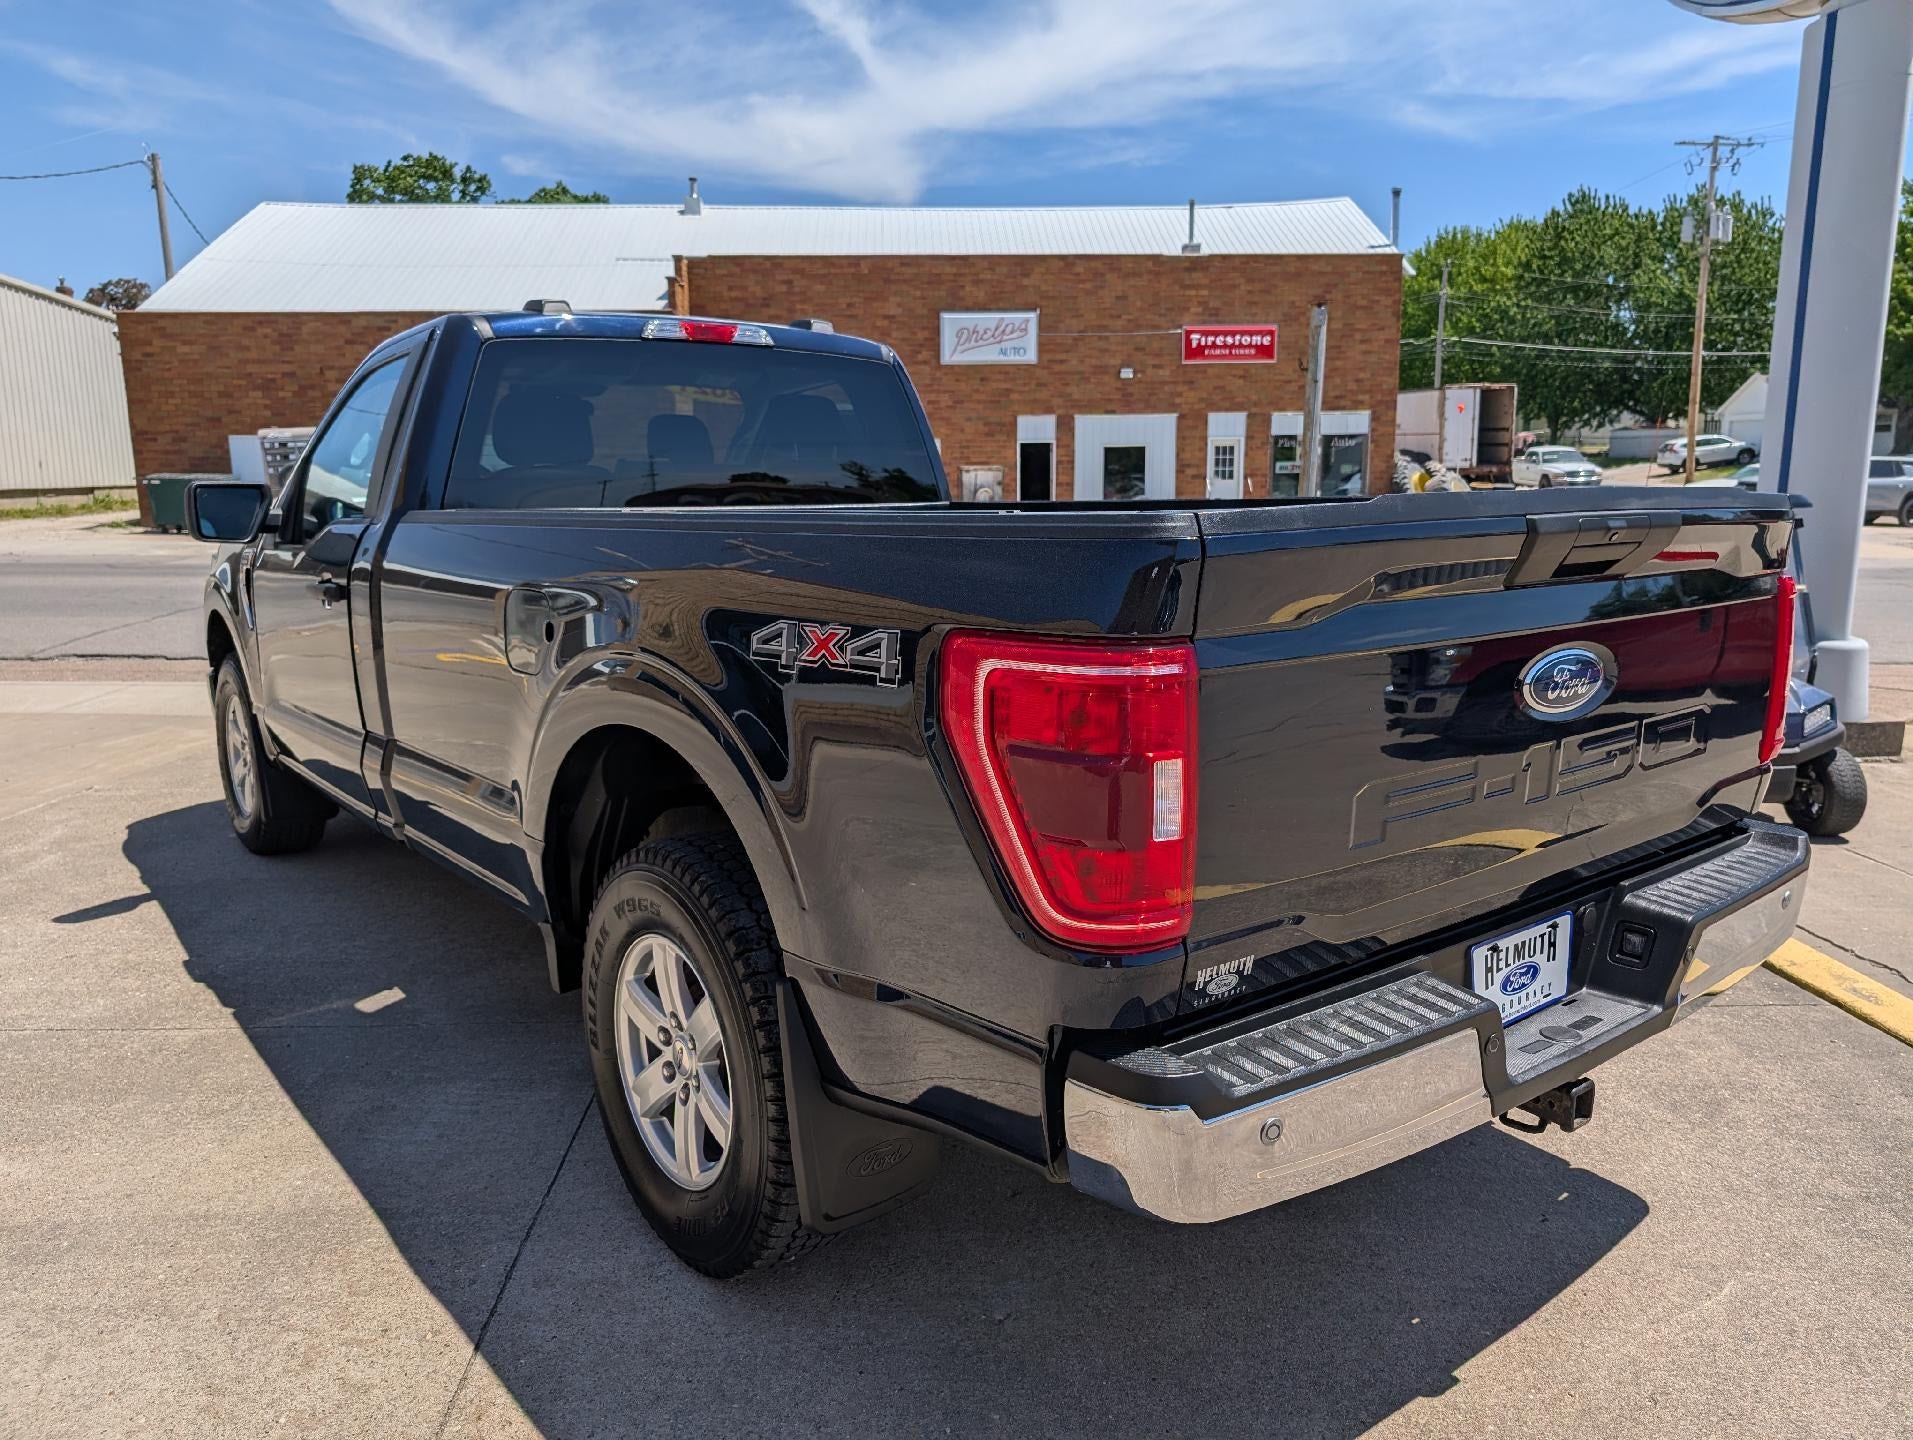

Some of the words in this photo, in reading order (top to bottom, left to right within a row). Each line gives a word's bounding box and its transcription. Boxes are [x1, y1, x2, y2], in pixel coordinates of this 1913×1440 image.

[950, 317, 1030, 359] Phelps
[999, 345, 1026, 358] AUTO
[1190, 333, 1271, 348] Firestone
[1547, 663, 1592, 700] Ford
[1350, 703, 1711, 849] F-150
[1194, 954, 1255, 991] HELMUTH
[1484, 925, 1559, 992] HELMUTH
[587, 920, 611, 1051] BLIZZAK
[1501, 981, 1552, 1013] GOURNEY
[1507, 966, 1534, 992] Ford
[860, 1143, 903, 1176] Ford
